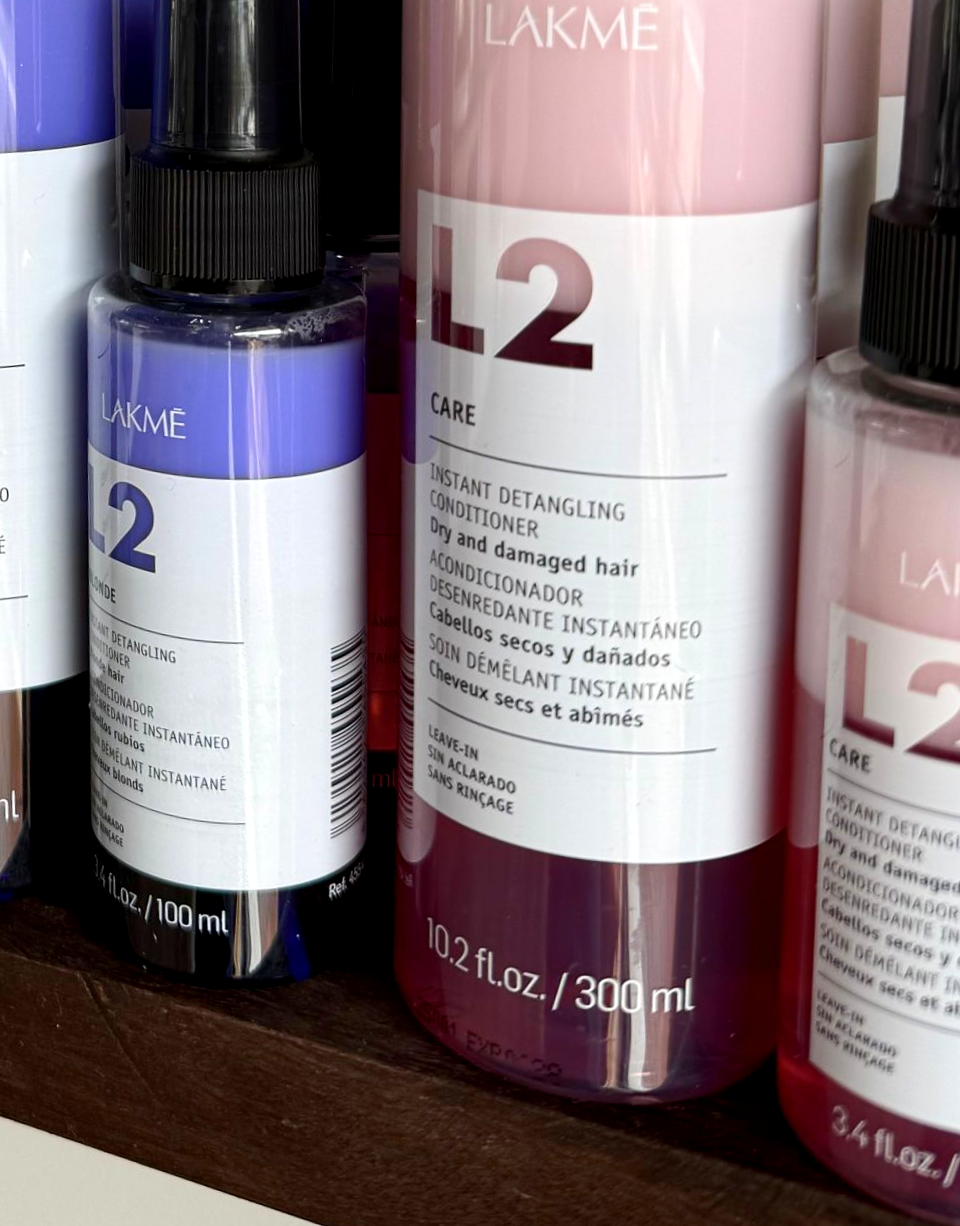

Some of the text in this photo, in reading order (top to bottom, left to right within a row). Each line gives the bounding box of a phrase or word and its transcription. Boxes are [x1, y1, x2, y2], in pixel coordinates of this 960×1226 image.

[431, 223, 594, 372] L2
[431, 392, 477, 427] CARE
[430, 462, 626, 522] INSTANT DETANGLING
[430, 489, 539, 539] CONDITIONER
[430, 516, 639, 579] Dry and damaged hair
[430, 549, 583, 609] ACONDICIONADOR
[430, 575, 703, 641] DESENREDANTE INSTANTÁNEO
[430, 601, 670, 667] Cabellos secos y dañados
[111, 629, 177, 663] DETANGLING
[429, 633, 460, 664] SOIN
[467, 652, 561, 692] DÉMÊLANT
[568, 677, 695, 702] INSTANTANÉ
[107, 664, 125, 684] hair
[429, 660, 644, 727] Cheveux secs et abîmés
[114, 729, 145, 753] rubios
[143, 722, 230, 750] INSTANTÁNEO
[428, 724, 479, 762] LEAVE-IN
[829, 737, 872, 775] CARE
[112, 766, 145, 793] blonds
[148, 765, 228, 791] INSTANTANÉ
[427, 764, 514, 815] SANS RINÇAGE
[428, 744, 517, 794] SIN ACLARADO
[826, 786, 884, 825] INSTANT
[824, 830, 846, 855] Dry
[850, 848, 877, 869] and
[825, 808, 923, 864] CONDITIONER
[822, 876, 933, 938] DESENREDANTE
[823, 857, 959, 921] ACONDICIONADOR
[156, 898, 193, 928] 100
[198, 910, 229, 934] ml
[819, 922, 850, 953] SOIN
[821, 898, 951, 968] Cabellos secos y
[427, 916, 469, 972] 10.2
[475, 948, 547, 1001] fl.oz.
[574, 975, 643, 1014] 300
[650, 977, 696, 1014] ml
[819, 944, 941, 1011] Cheveux secs et
[815, 1003, 898, 1059] SIN ACLARADO
[816, 988, 865, 1027] LEAVE-IN
[815, 1021, 896, 1075] SANS RINÇAGE
[831, 1104, 870, 1150] 3.4
[873, 1127, 943, 1181] fl.oz.
